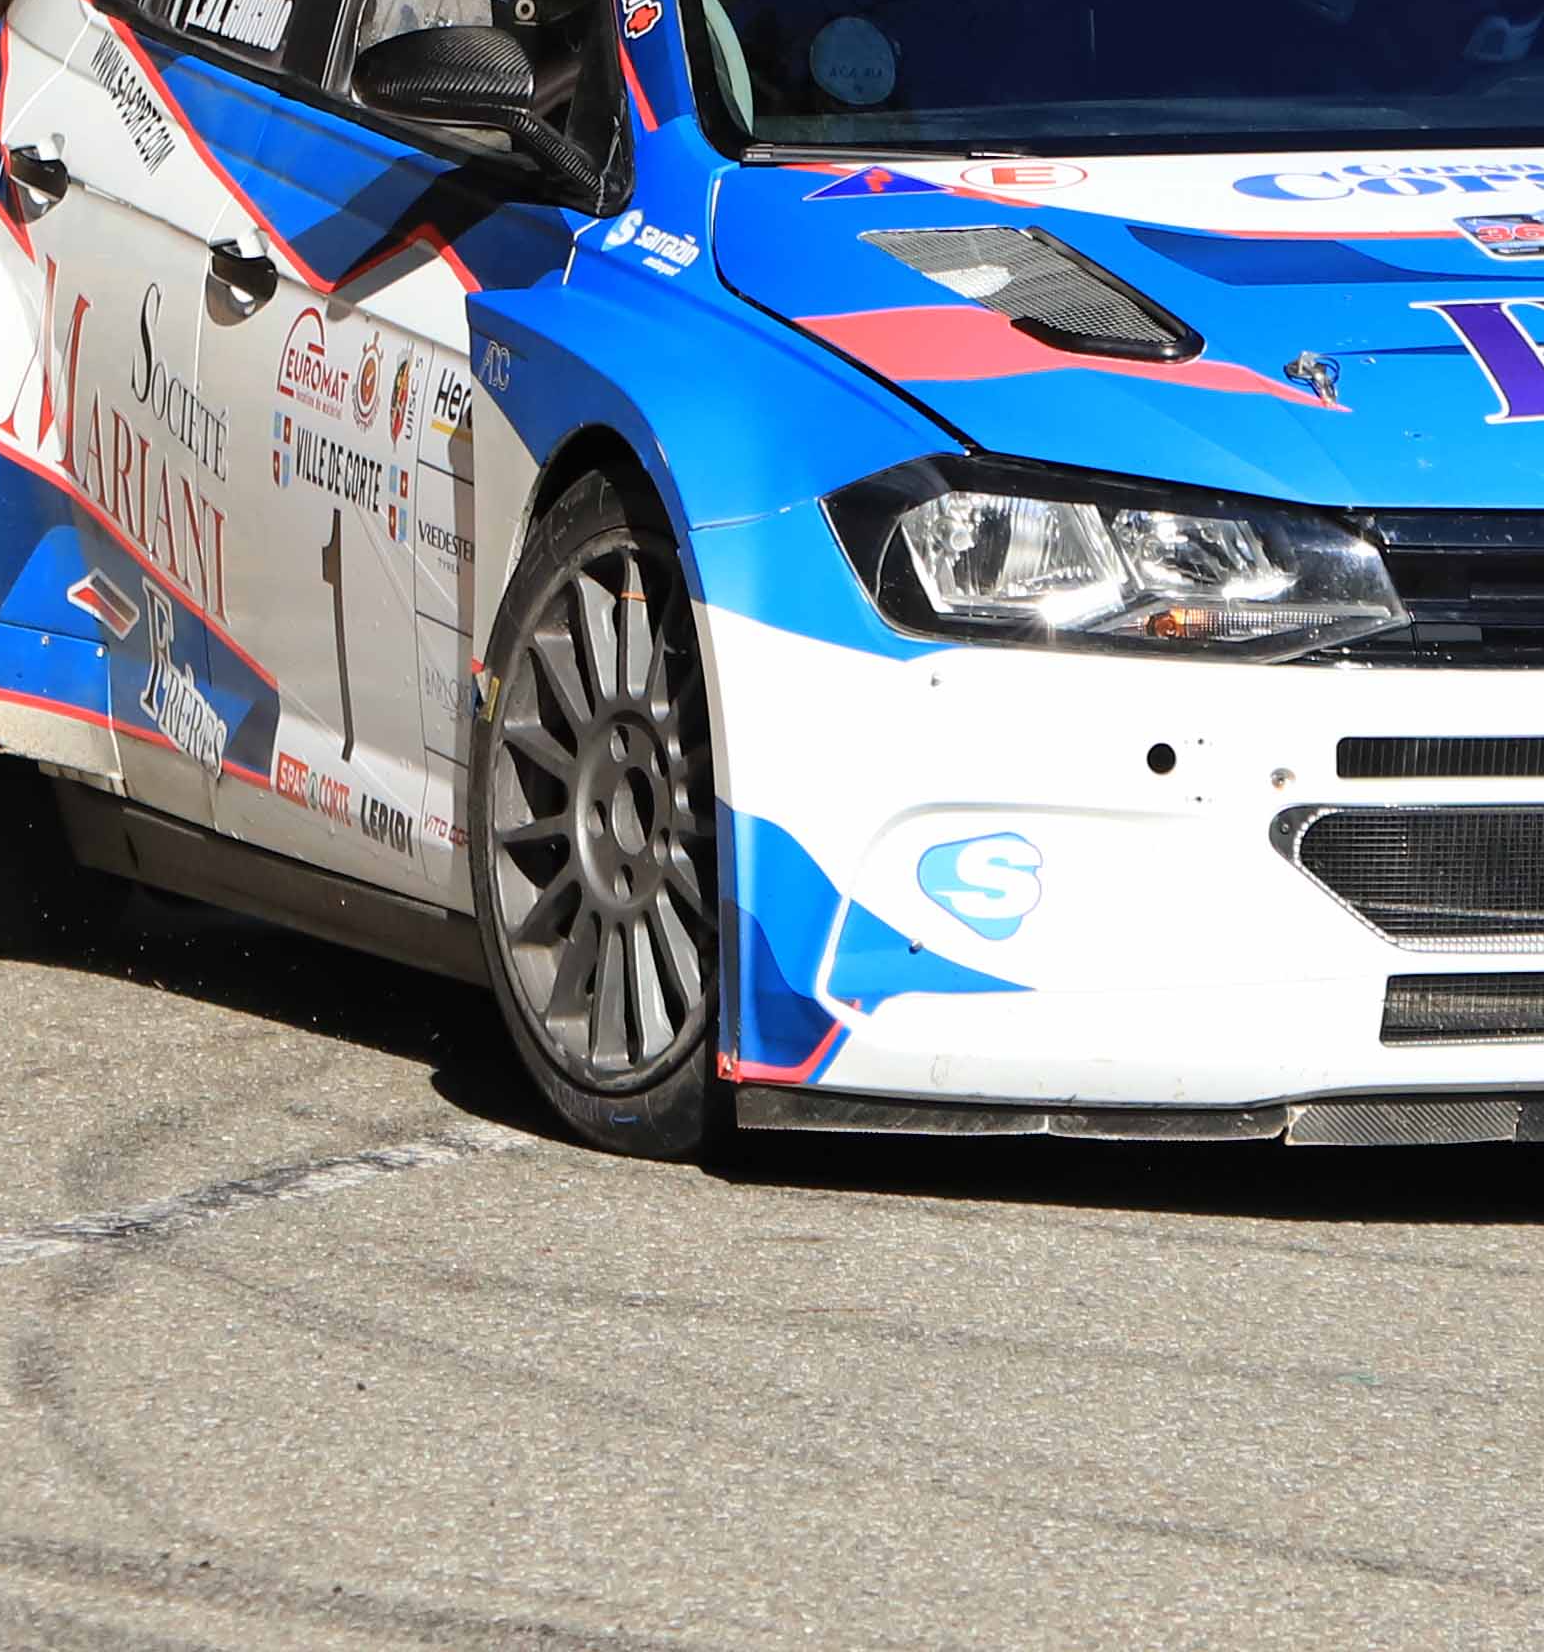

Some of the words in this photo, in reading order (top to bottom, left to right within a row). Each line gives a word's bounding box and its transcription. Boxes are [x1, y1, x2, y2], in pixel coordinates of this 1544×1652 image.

[991, 166, 1057, 186] E
[285, 348, 350, 403] EUROMAT
[296, 426, 326, 488] VILLE
[328, 445, 342, 495] DE
[344, 451, 383, 513] CORTE
[322, 508, 355, 763] 1
[279, 760, 307, 802] SPAR
[319, 773, 352, 828] CORTE
[360, 793, 414, 859] LEPIDI
